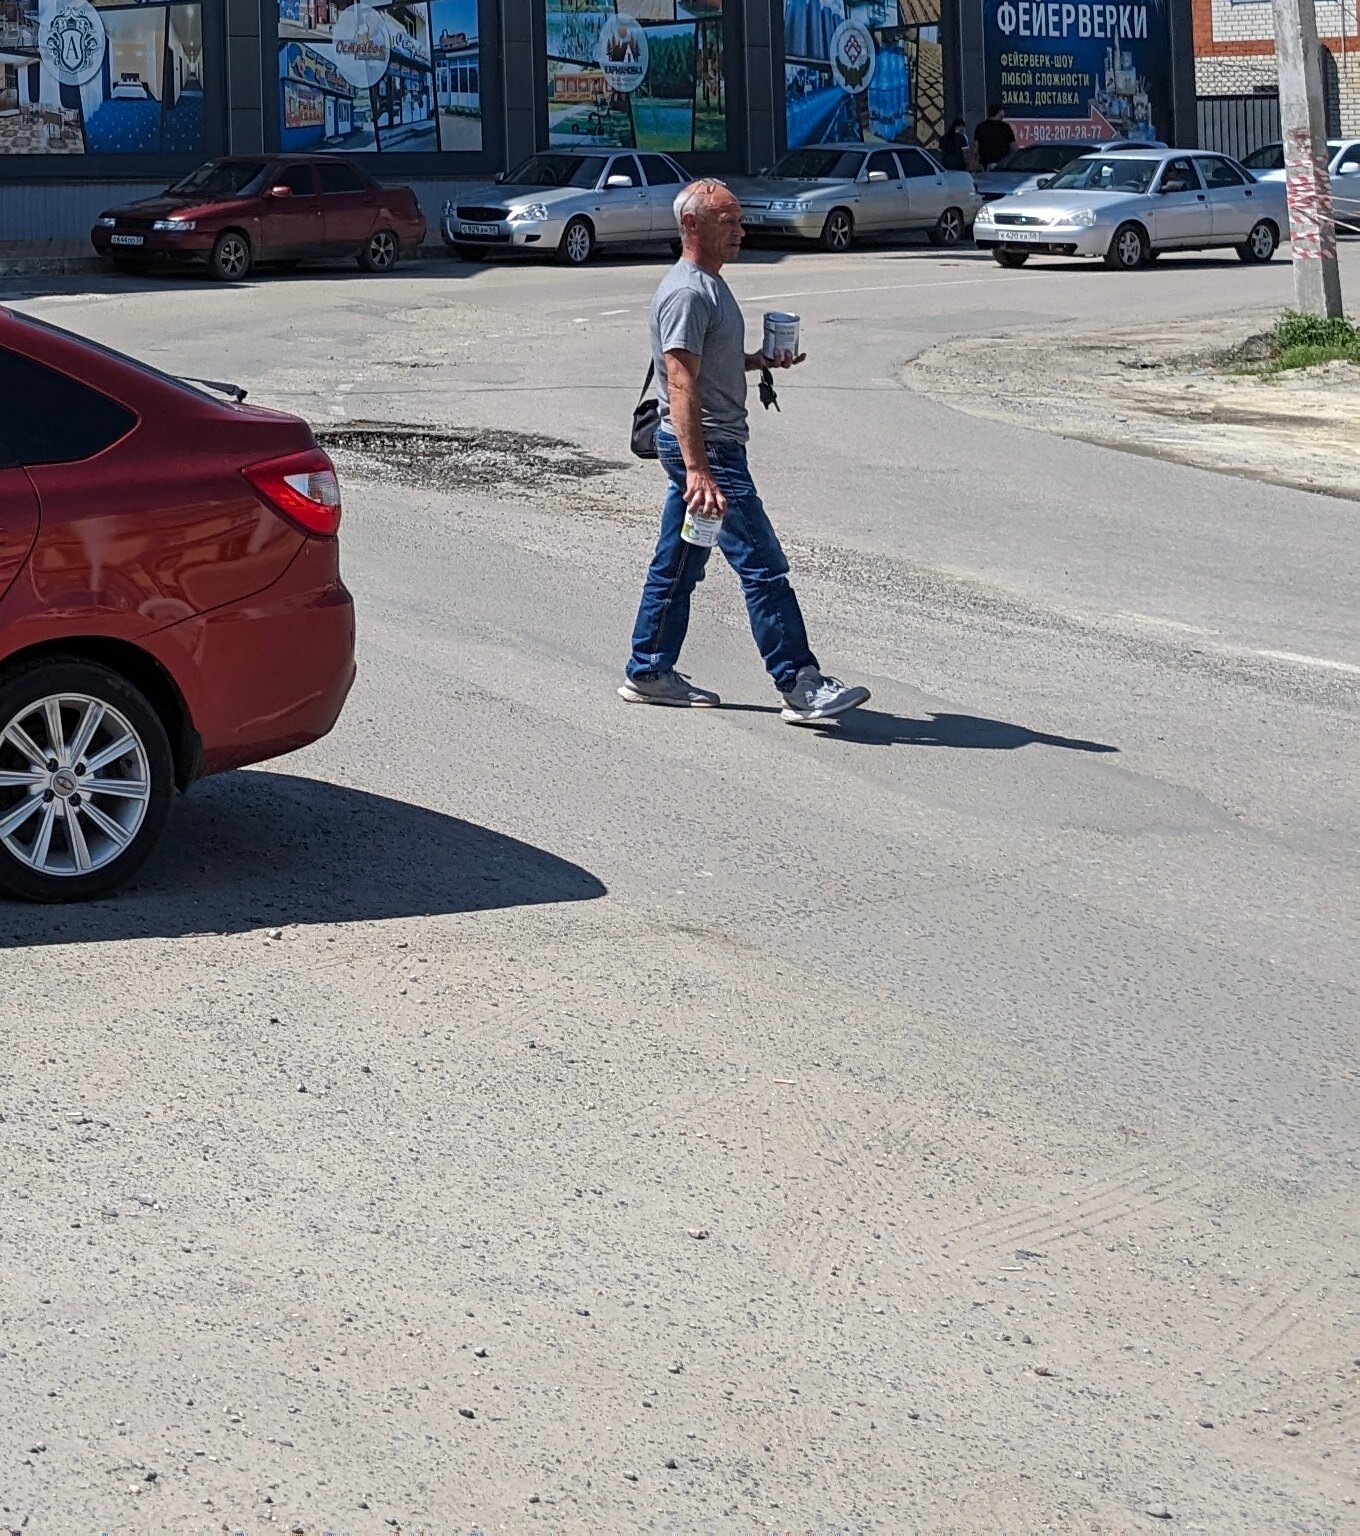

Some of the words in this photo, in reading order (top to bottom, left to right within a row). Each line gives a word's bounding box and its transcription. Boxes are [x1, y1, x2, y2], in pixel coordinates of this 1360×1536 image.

[1000, 51, 1074, 69] ФЕЙЕРВЕРК-ШОУ
[1001, 70, 1033, 86] ЛЮБОЙ
[1035, 73, 1090, 87] СЛОЖНОСТИ
[1035, 91, 1080, 106] ДОСТАВКА
